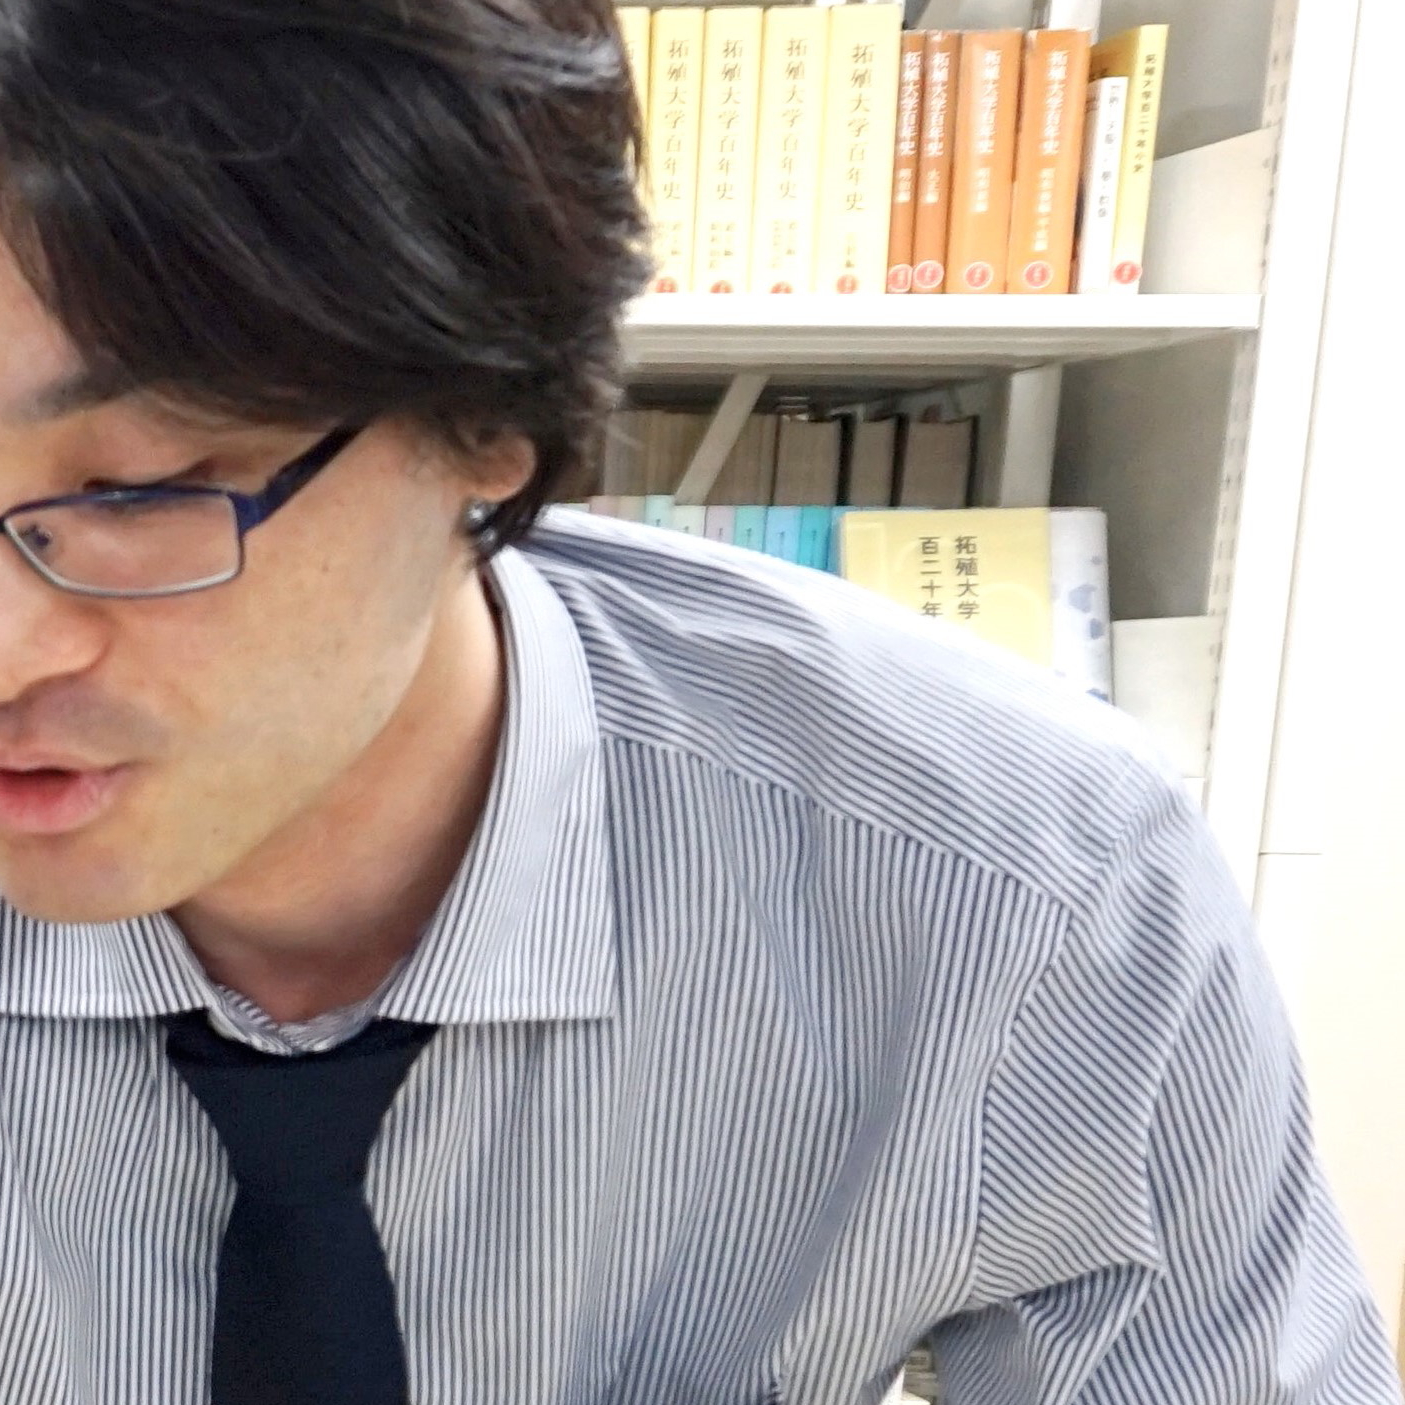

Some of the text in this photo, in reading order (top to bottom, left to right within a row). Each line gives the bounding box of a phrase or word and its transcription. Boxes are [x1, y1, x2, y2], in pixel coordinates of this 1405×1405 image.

[663, 39, 689, 200] 拓殖大学百年史
[717, 39, 743, 200] 拓殖大学百年史
[779, 38, 808, 200] 拓殖大学百年史
[845, 43, 876, 211] 拓殖大学百年史
[926, 50, 952, 157] 拓殖大学百年史
[977, 50, 1002, 155] 拓殖大学百年史
[1041, 50, 1068, 155] 拓殖大学百年史
[919, 535, 943, 618] 百二十年
[955, 535, 980, 620] 拓殖大学
